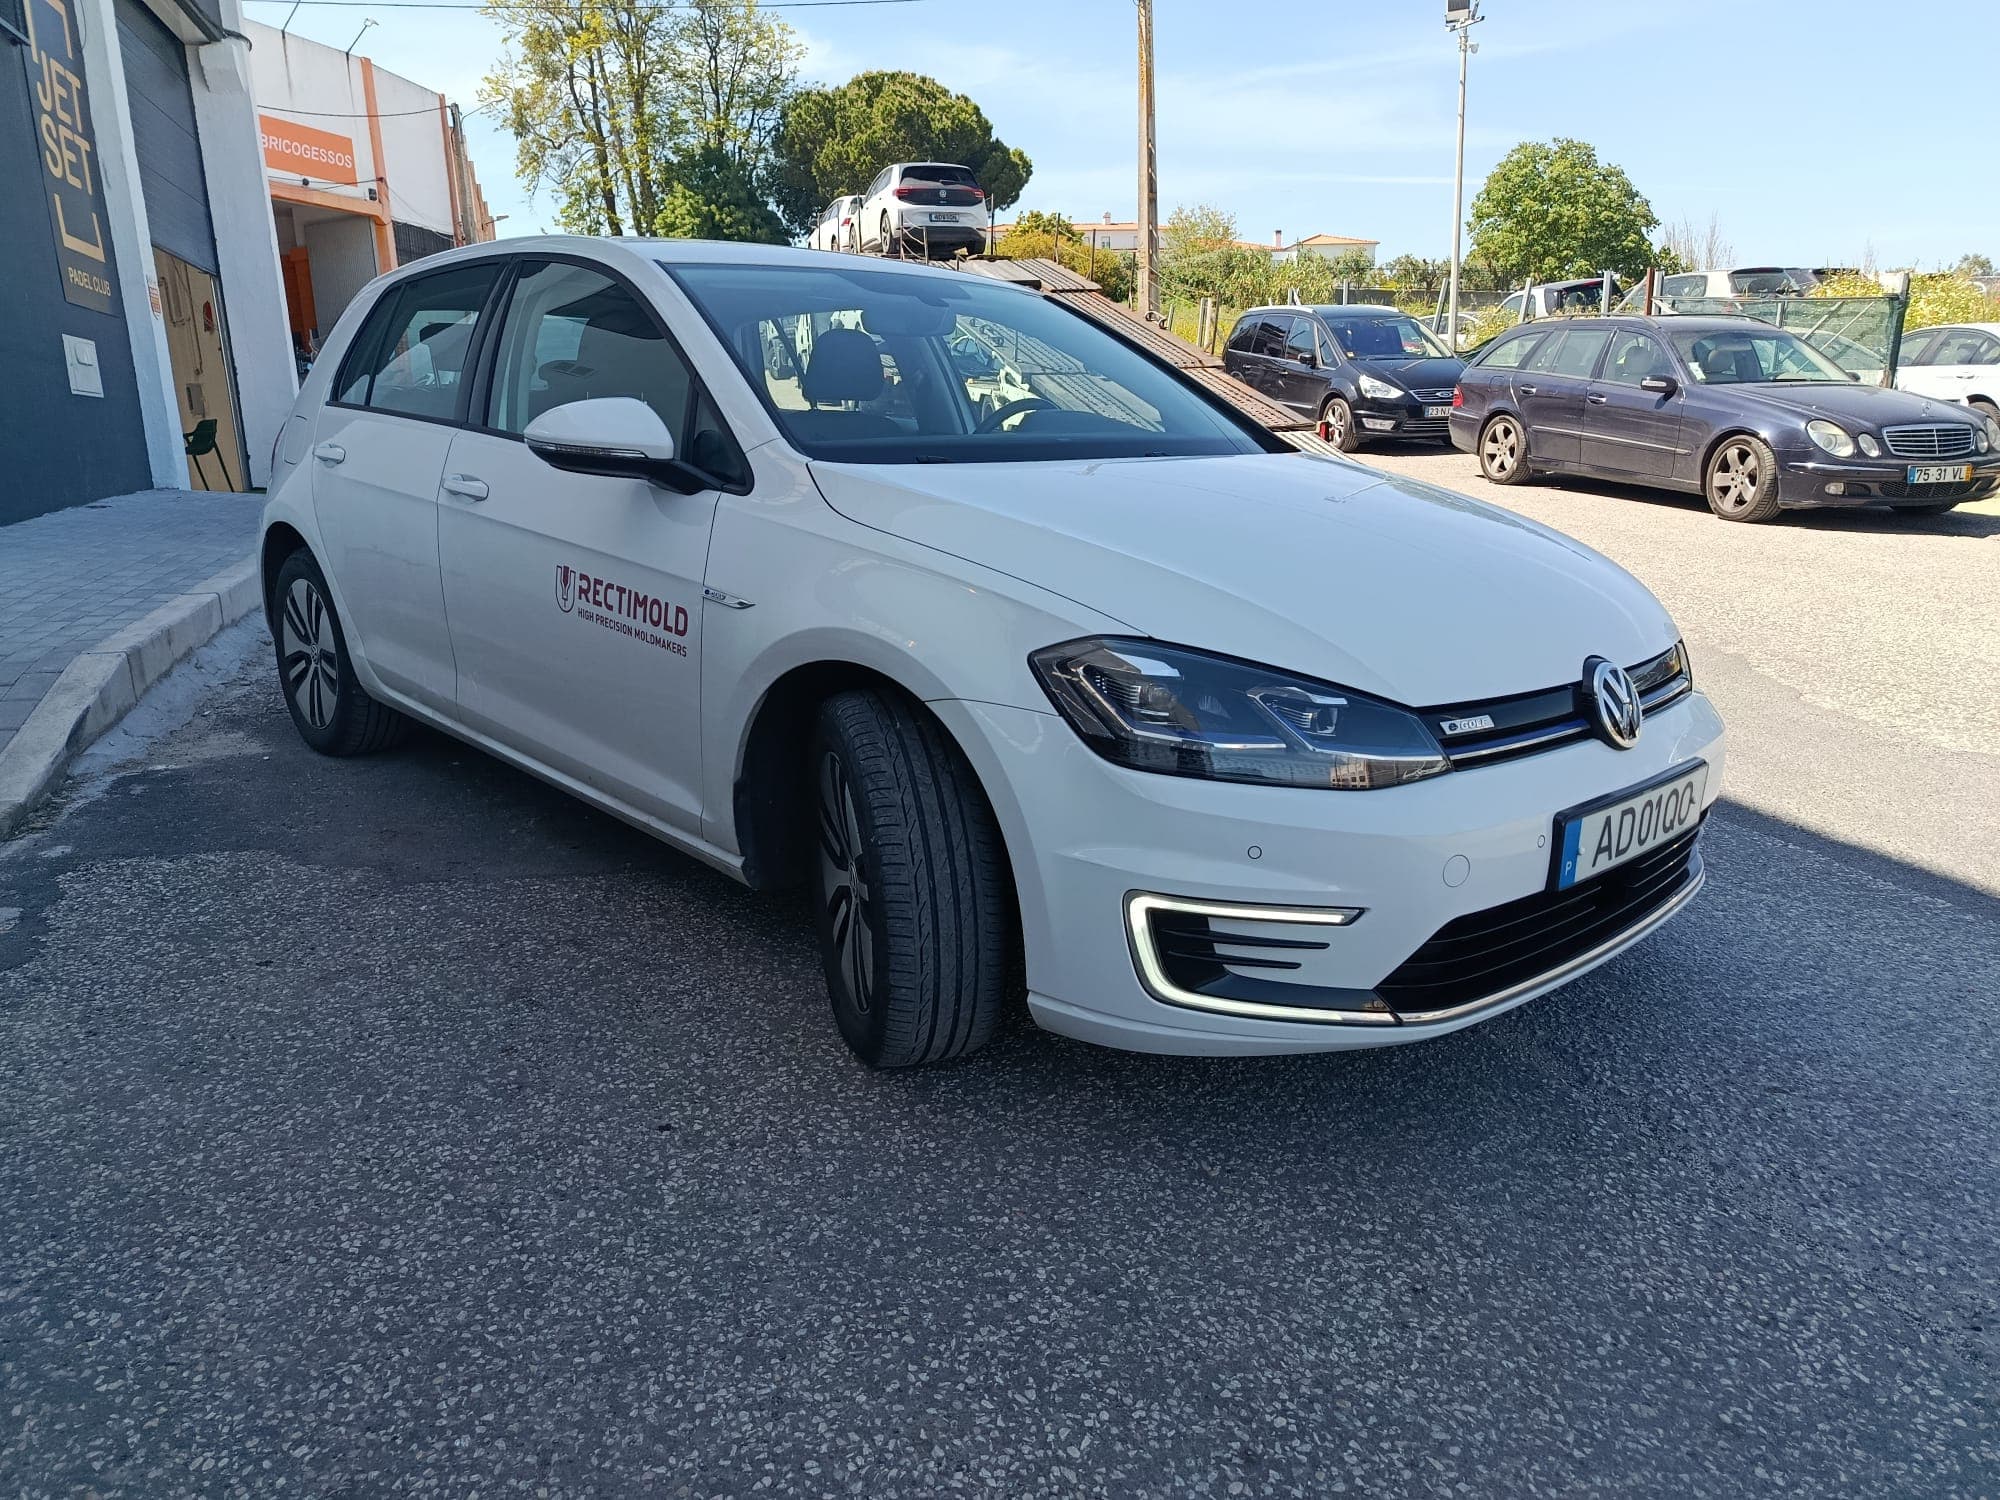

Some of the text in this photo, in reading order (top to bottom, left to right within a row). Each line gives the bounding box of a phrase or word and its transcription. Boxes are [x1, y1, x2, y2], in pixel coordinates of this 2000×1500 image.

[37, 50, 81, 133] JET
[41, 113, 91, 195] SET
[68, 266, 112, 297] PADEL CLUB
[577, 607, 688, 658] HIGH PRECISION MOLDMAKERS
[578, 573, 689, 637] RECTIMOLD
[1564, 860, 1573, 876] P
